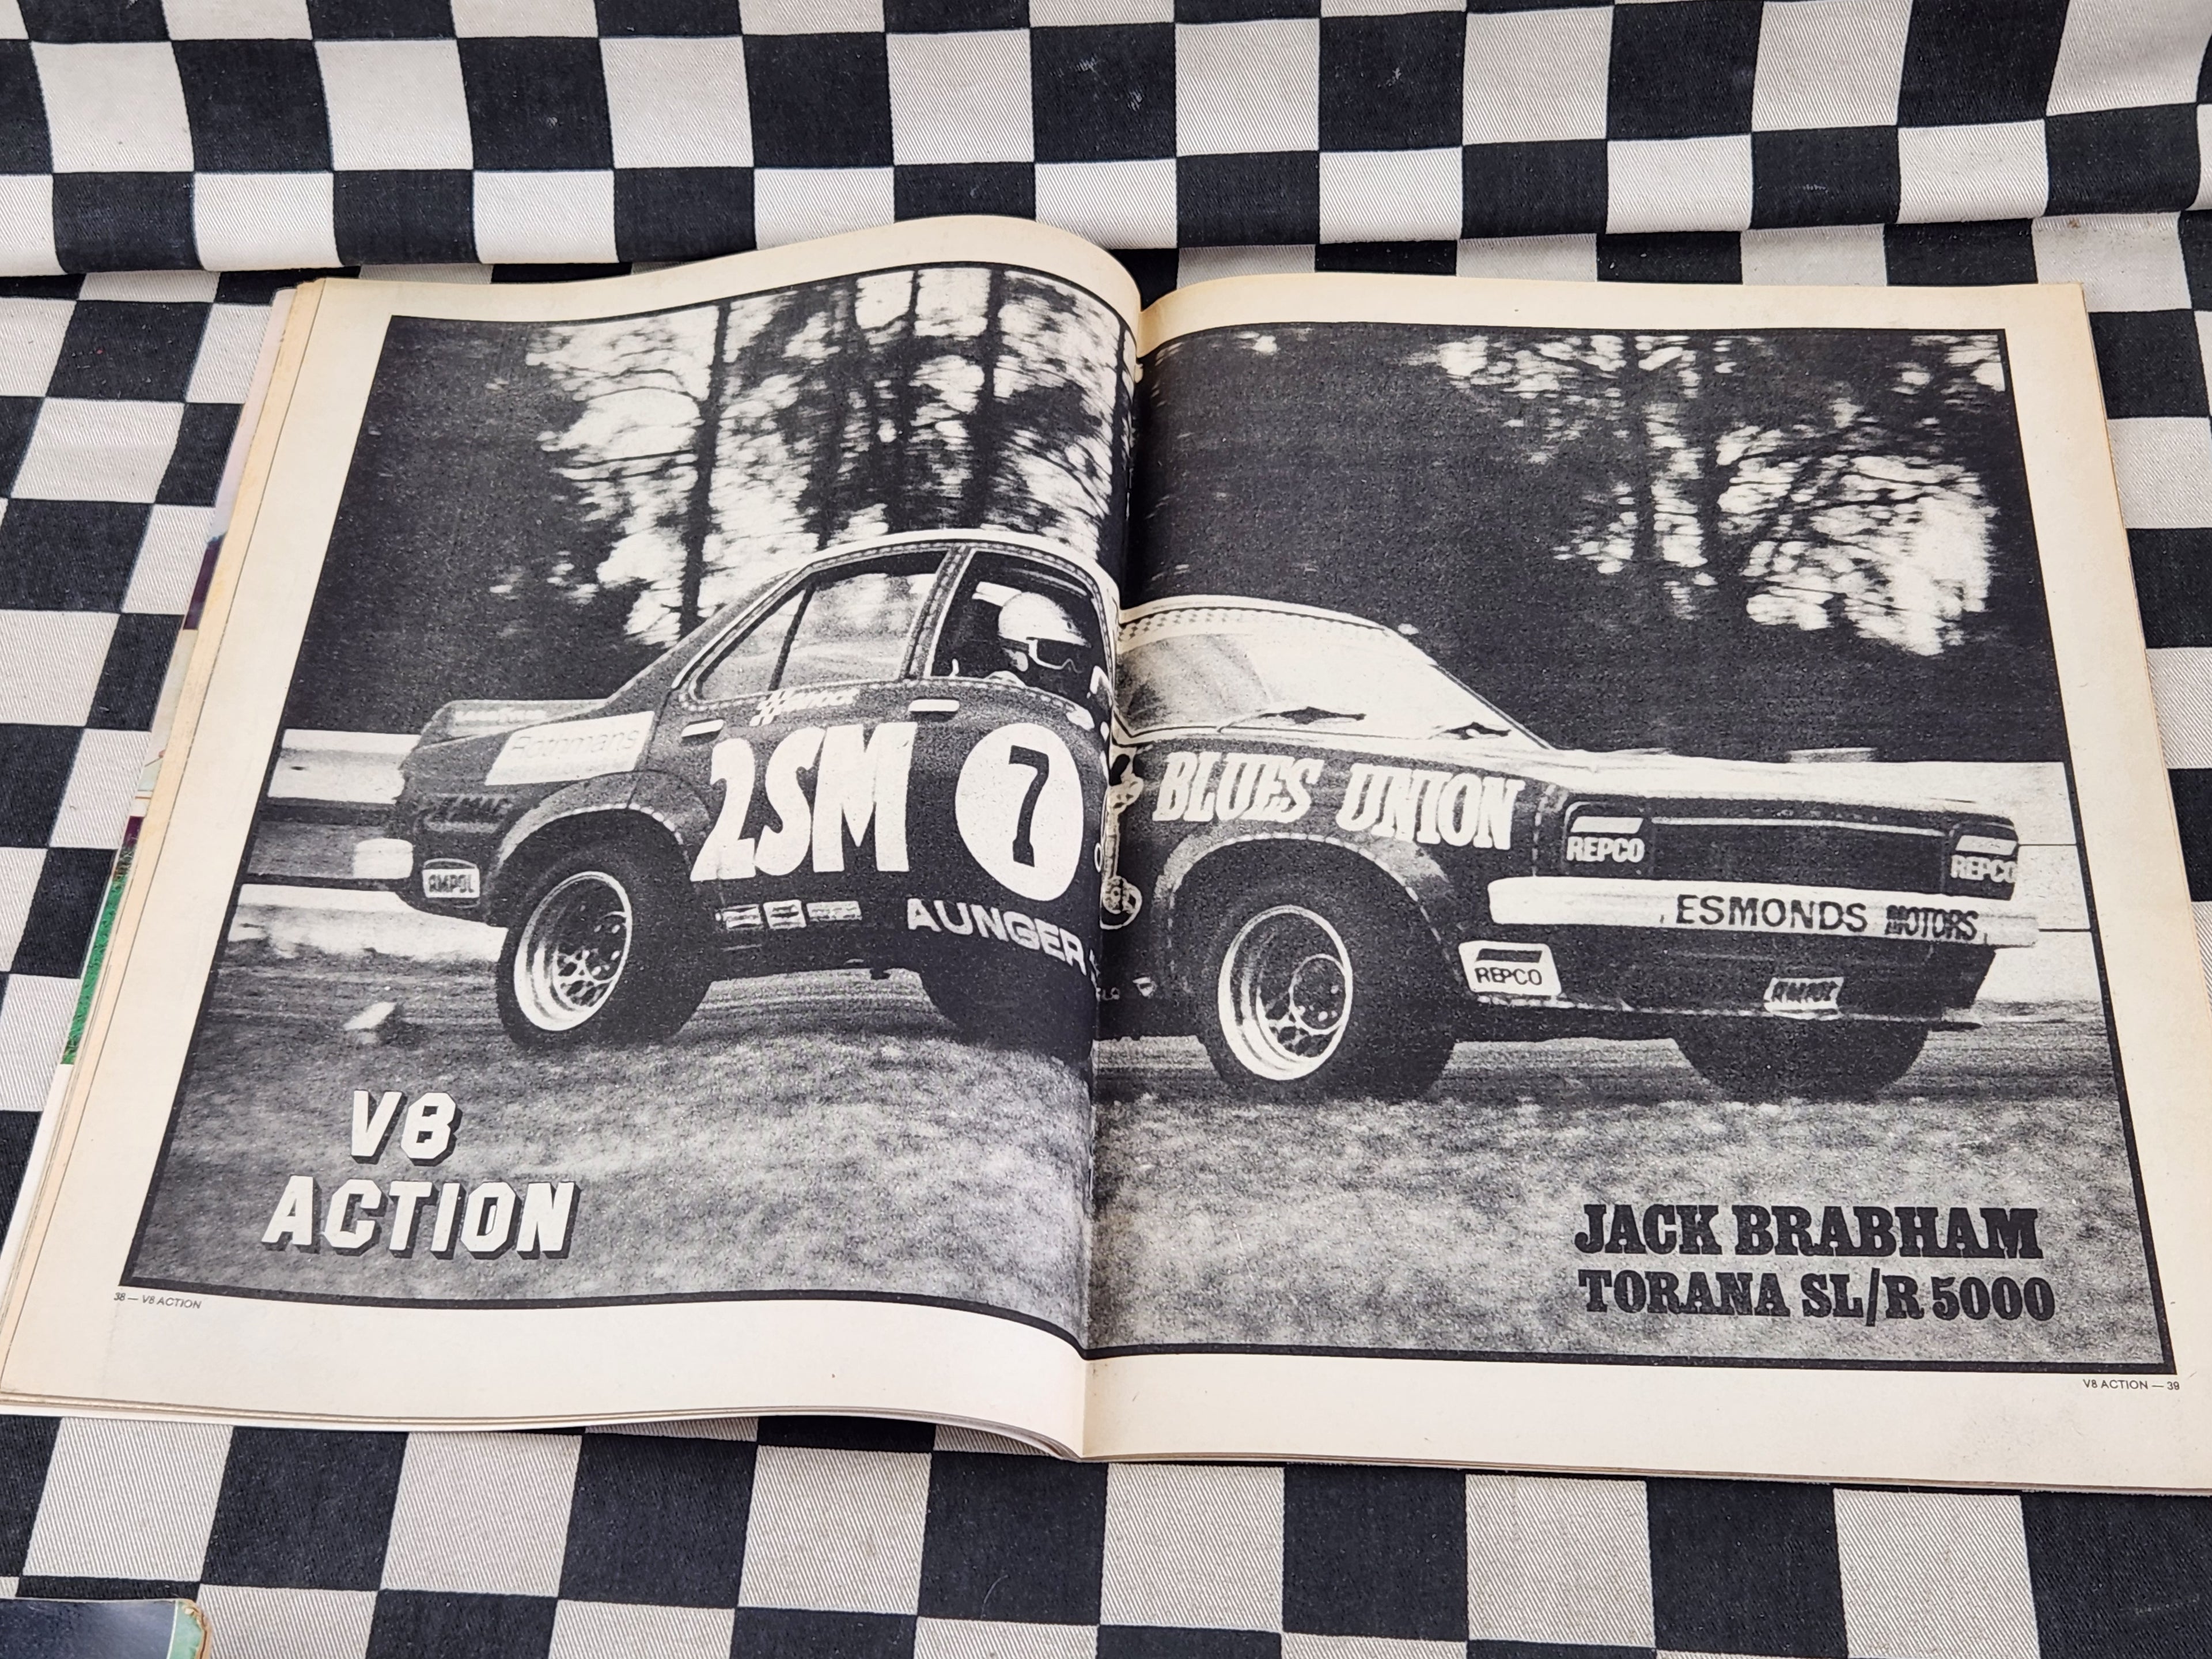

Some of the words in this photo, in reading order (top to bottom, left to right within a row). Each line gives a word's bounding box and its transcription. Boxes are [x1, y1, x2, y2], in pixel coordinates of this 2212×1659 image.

[690, 722, 918, 881] 2SM
[1009, 745, 1050, 868] 7
[1152, 751, 1324, 823] BLUES
[1336, 763, 1525, 850] UNION
[1566, 836, 1645, 863] REPCO
[907, 898, 1087, 976] AUNGER
[1676, 893, 1869, 933] ESMONDS
[1884, 904, 1979, 941] MOTORS
[1474, 967, 1543, 986] REPCO
[350, 1090, 461, 1165] V8
[261, 1175, 581, 1259] ACTION
[1574, 1203, 1722, 1255] JACK
[1732, 1204, 2044, 1259] BRABHAM
[113, 1292, 126, 1301] 38
[142, 1294, 156, 1304] V8
[156, 1296, 202, 1309] ACTION
[1577, 1268, 1791, 1317] TORANA
[1801, 1267, 1925, 1327] SL/R
[1931, 1276, 2056, 1322] 5000
[2082, 1378, 2098, 1388] V8
[2100, 1379, 2149, 1389] ACTION
